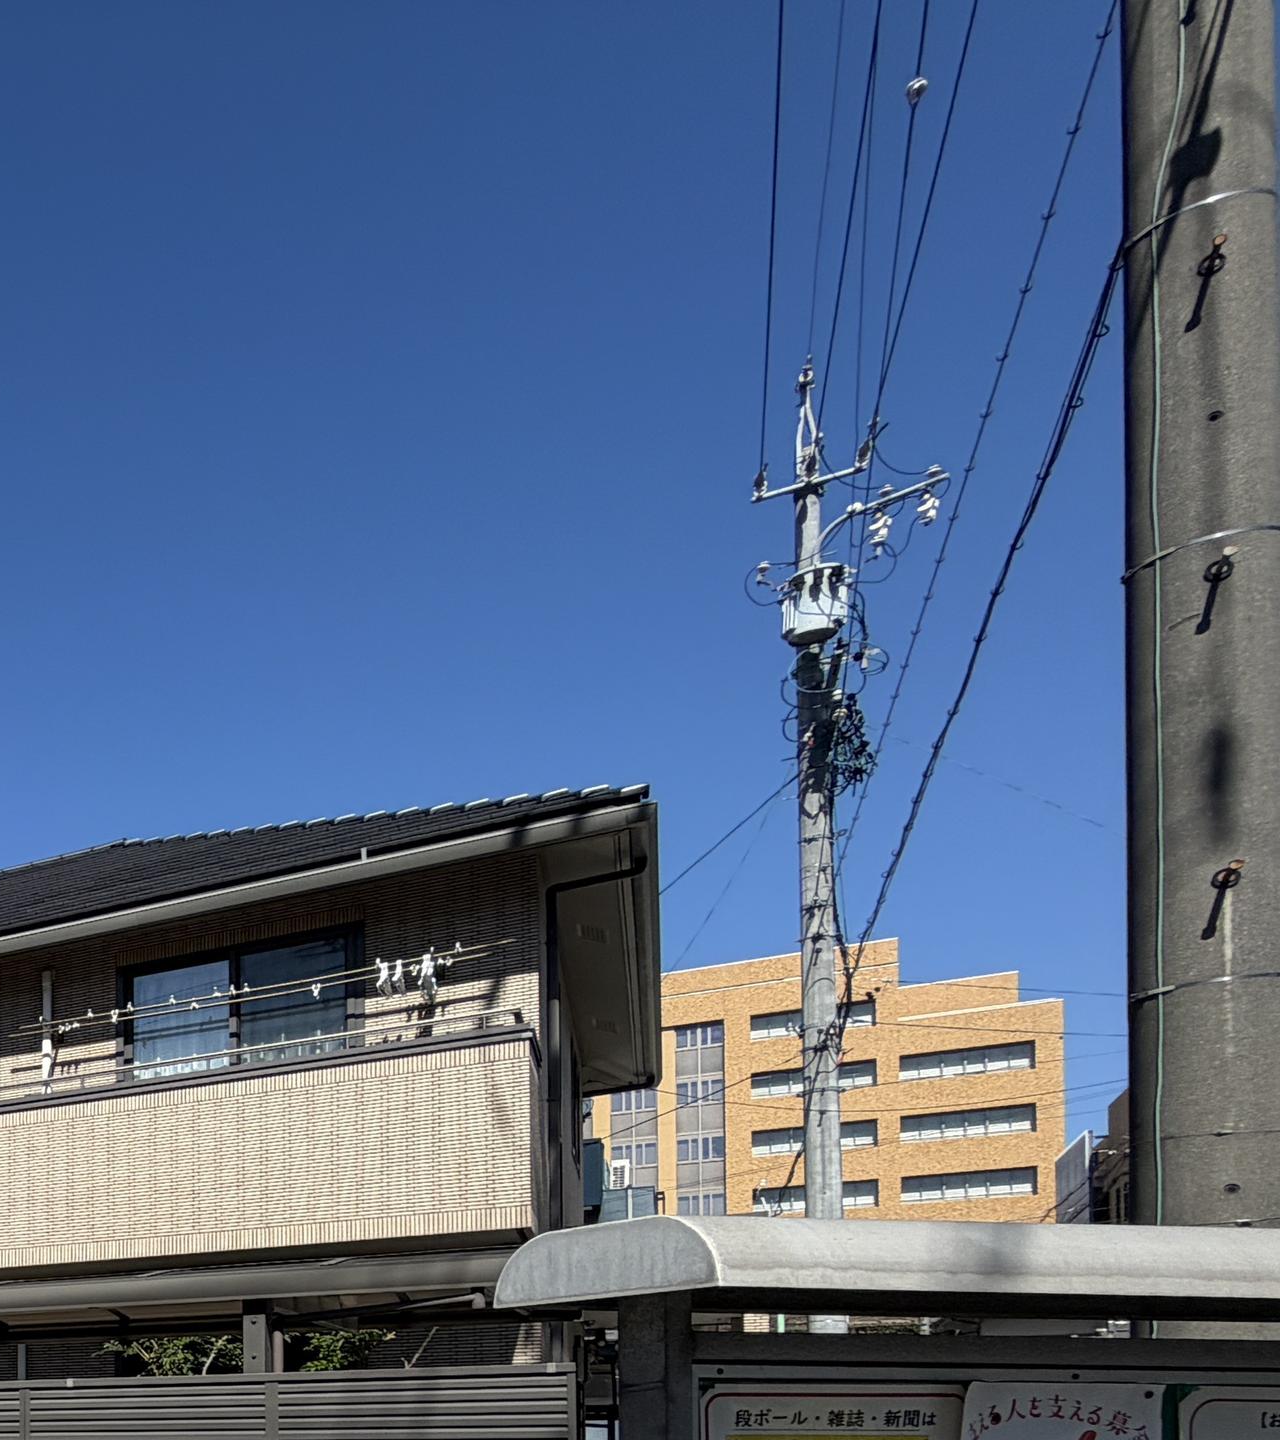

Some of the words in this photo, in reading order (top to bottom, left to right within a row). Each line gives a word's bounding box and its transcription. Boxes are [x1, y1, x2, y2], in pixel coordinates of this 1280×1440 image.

[734, 1408, 937, 1428] 段ボール・雑誌・新聞は
